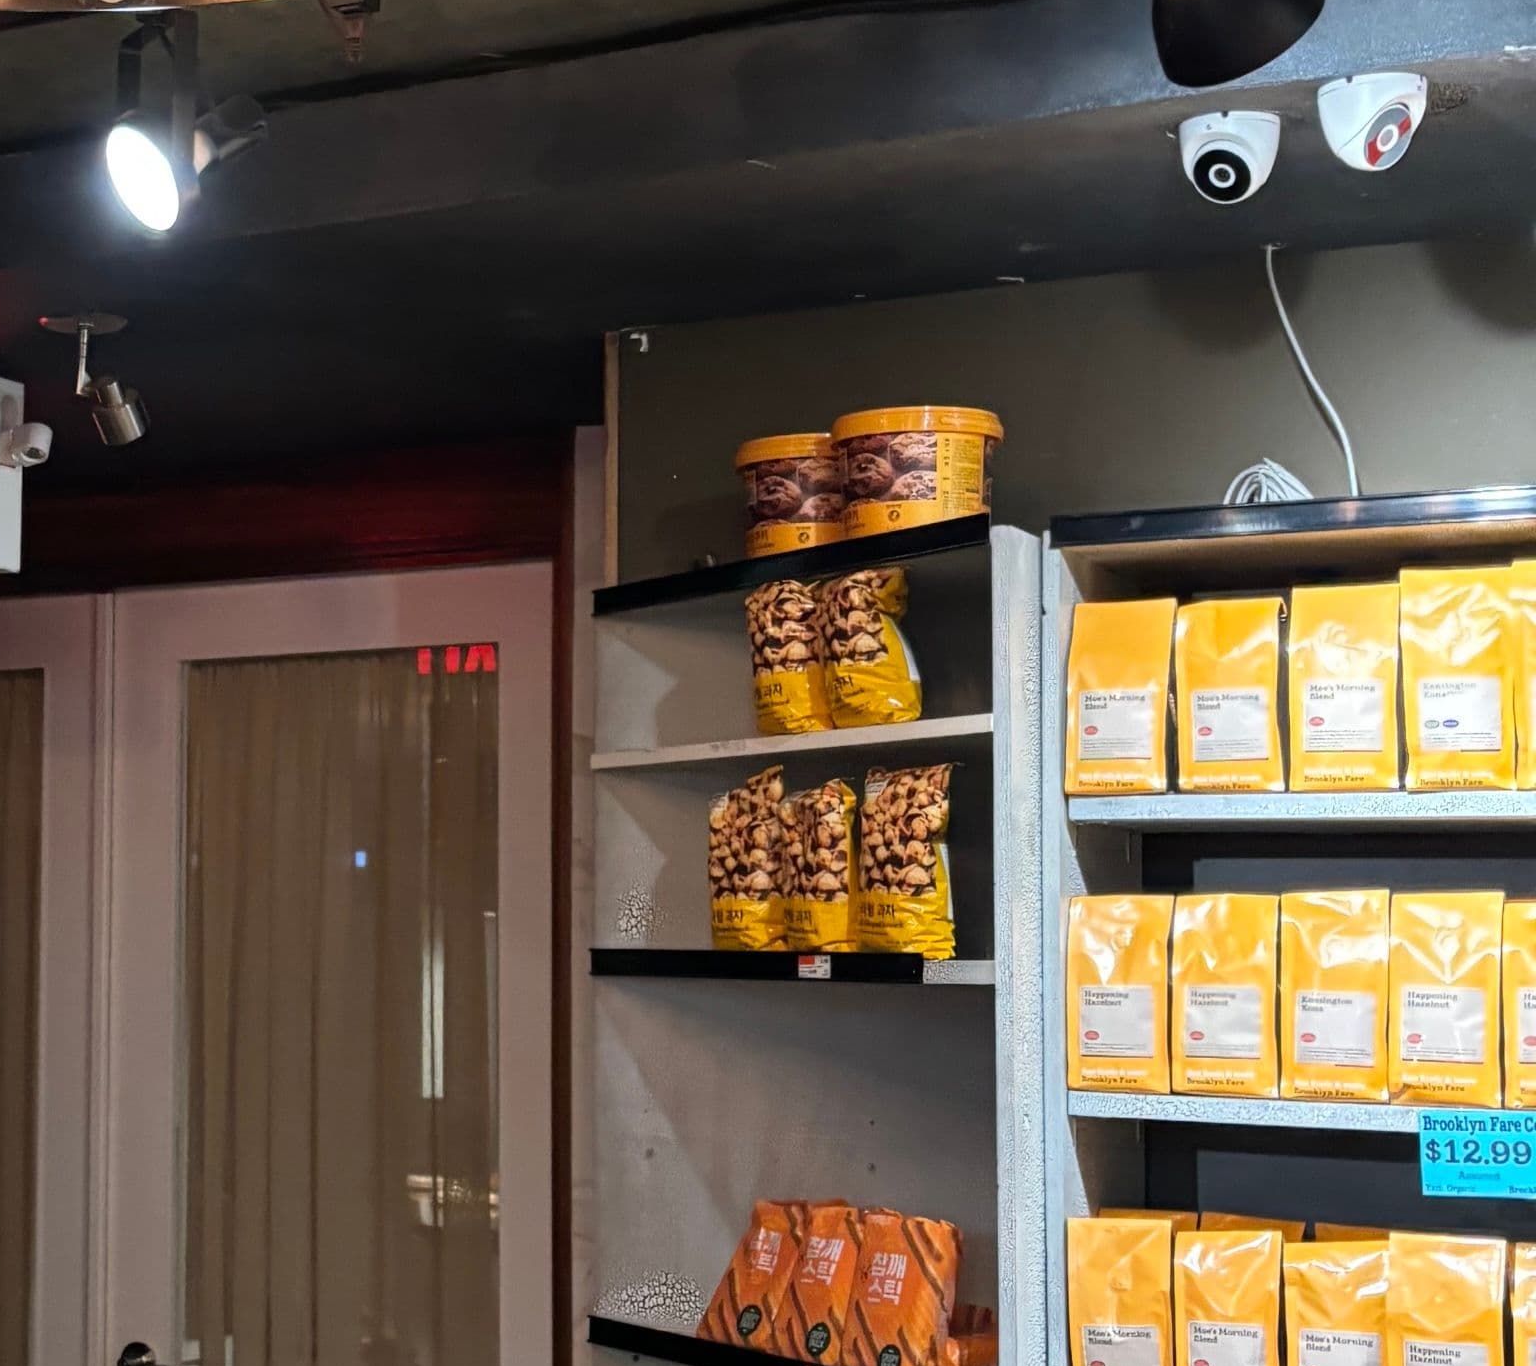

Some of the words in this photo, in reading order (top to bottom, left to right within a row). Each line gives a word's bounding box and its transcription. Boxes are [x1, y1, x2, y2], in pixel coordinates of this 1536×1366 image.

[1423, 1115, 1487, 1135] Brooklyn
[1490, 1116, 1521, 1132] Fare
[1425, 1139, 1532, 1165] $12.99
